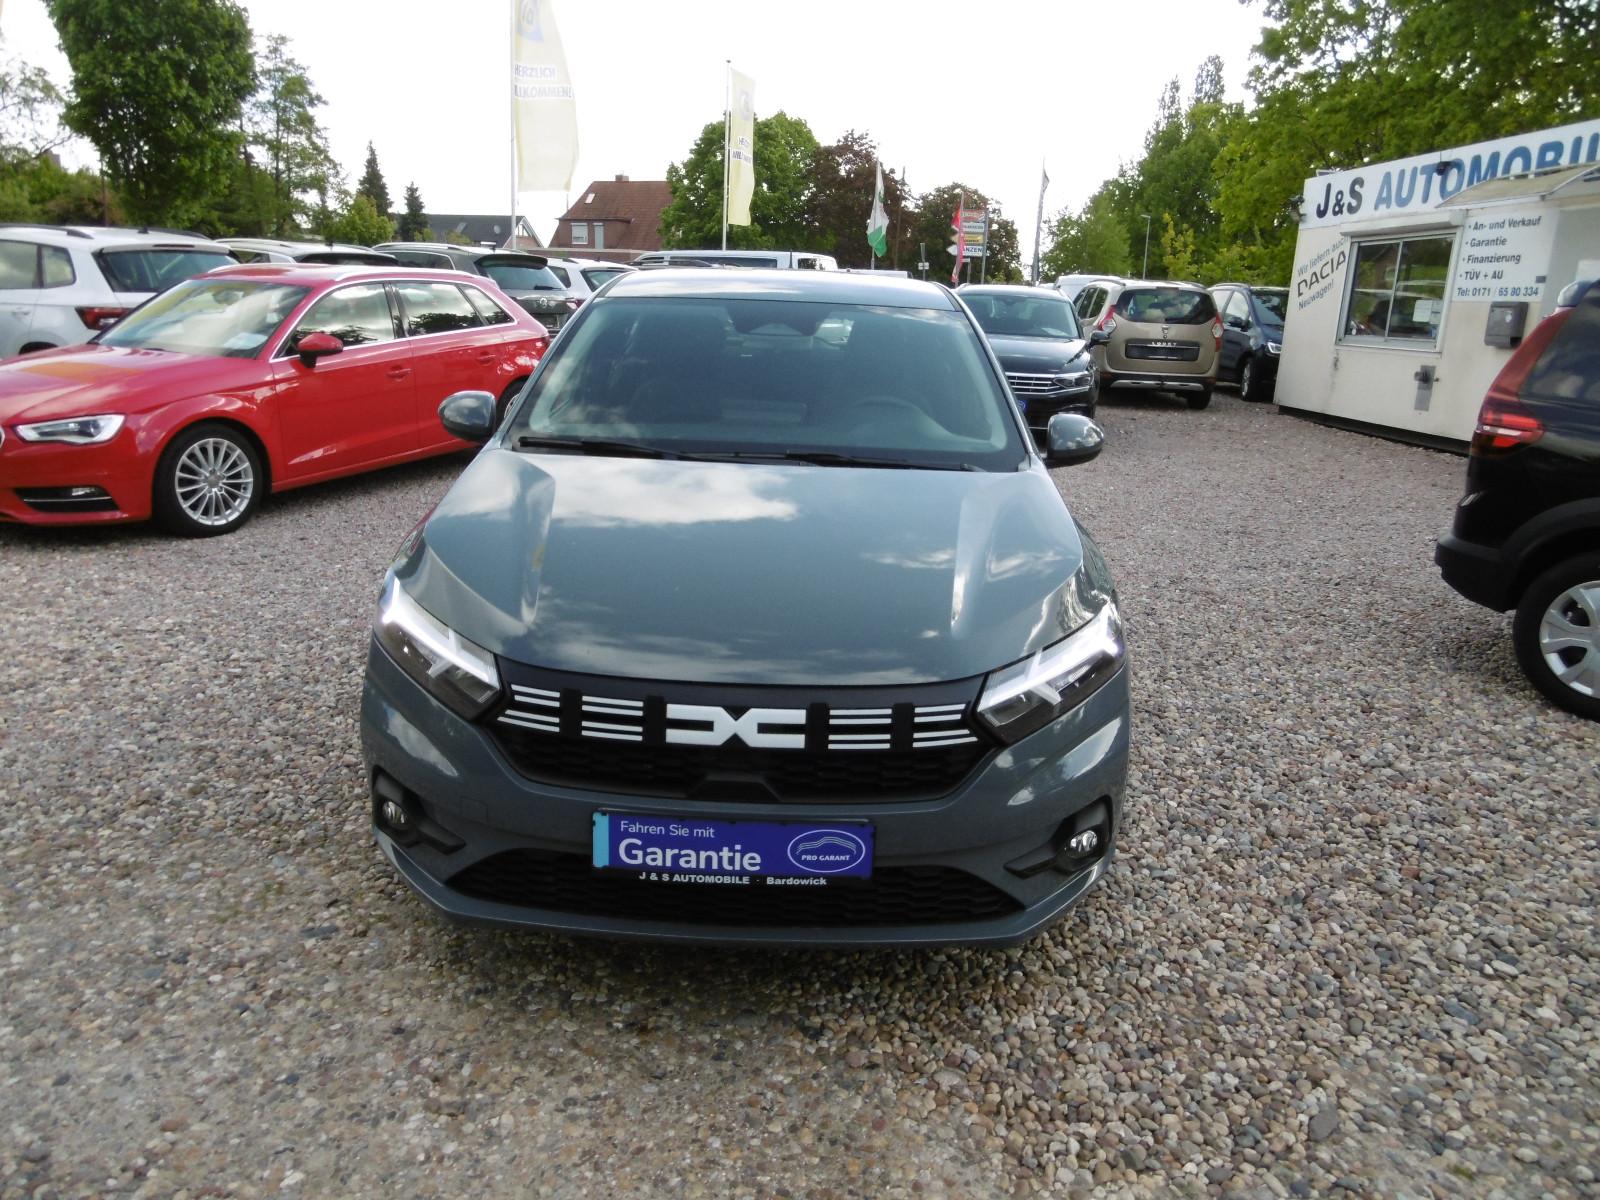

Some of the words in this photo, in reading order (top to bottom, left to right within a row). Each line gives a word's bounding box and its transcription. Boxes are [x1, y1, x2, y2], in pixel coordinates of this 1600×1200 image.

[1316, 176, 1364, 219] J&S
[1473, 221, 1487, 231] An-
[1489, 219, 1506, 230] und
[1508, 216, 1542, 228] Verkauf
[1470, 236, 1507, 248] Garantie
[1466, 254, 1521, 265] Finanzierung
[1298, 250, 1347, 298] DACIA
[1464, 268, 1481, 280] TÜV
[1491, 270, 1504, 280] AU
[1457, 287, 1470, 297] Tel:
[1472, 287, 1491, 297] 0171
[1498, 287, 1508, 296] 65
[1522, 287, 1539, 296] 334
[620, 821, 665, 835] Fahren
[669, 824, 690, 837] Sie
[693, 826, 715, 838] mit
[618, 838, 761, 871] Garantie
[819, 854, 850, 862] GARANT
[639, 872, 646, 880] J
[650, 872, 659, 881] &
[662, 873, 669, 882] S
[673, 874, 750, 884] AUTOMOBILE
[767, 877, 827, 885] Bardowick
